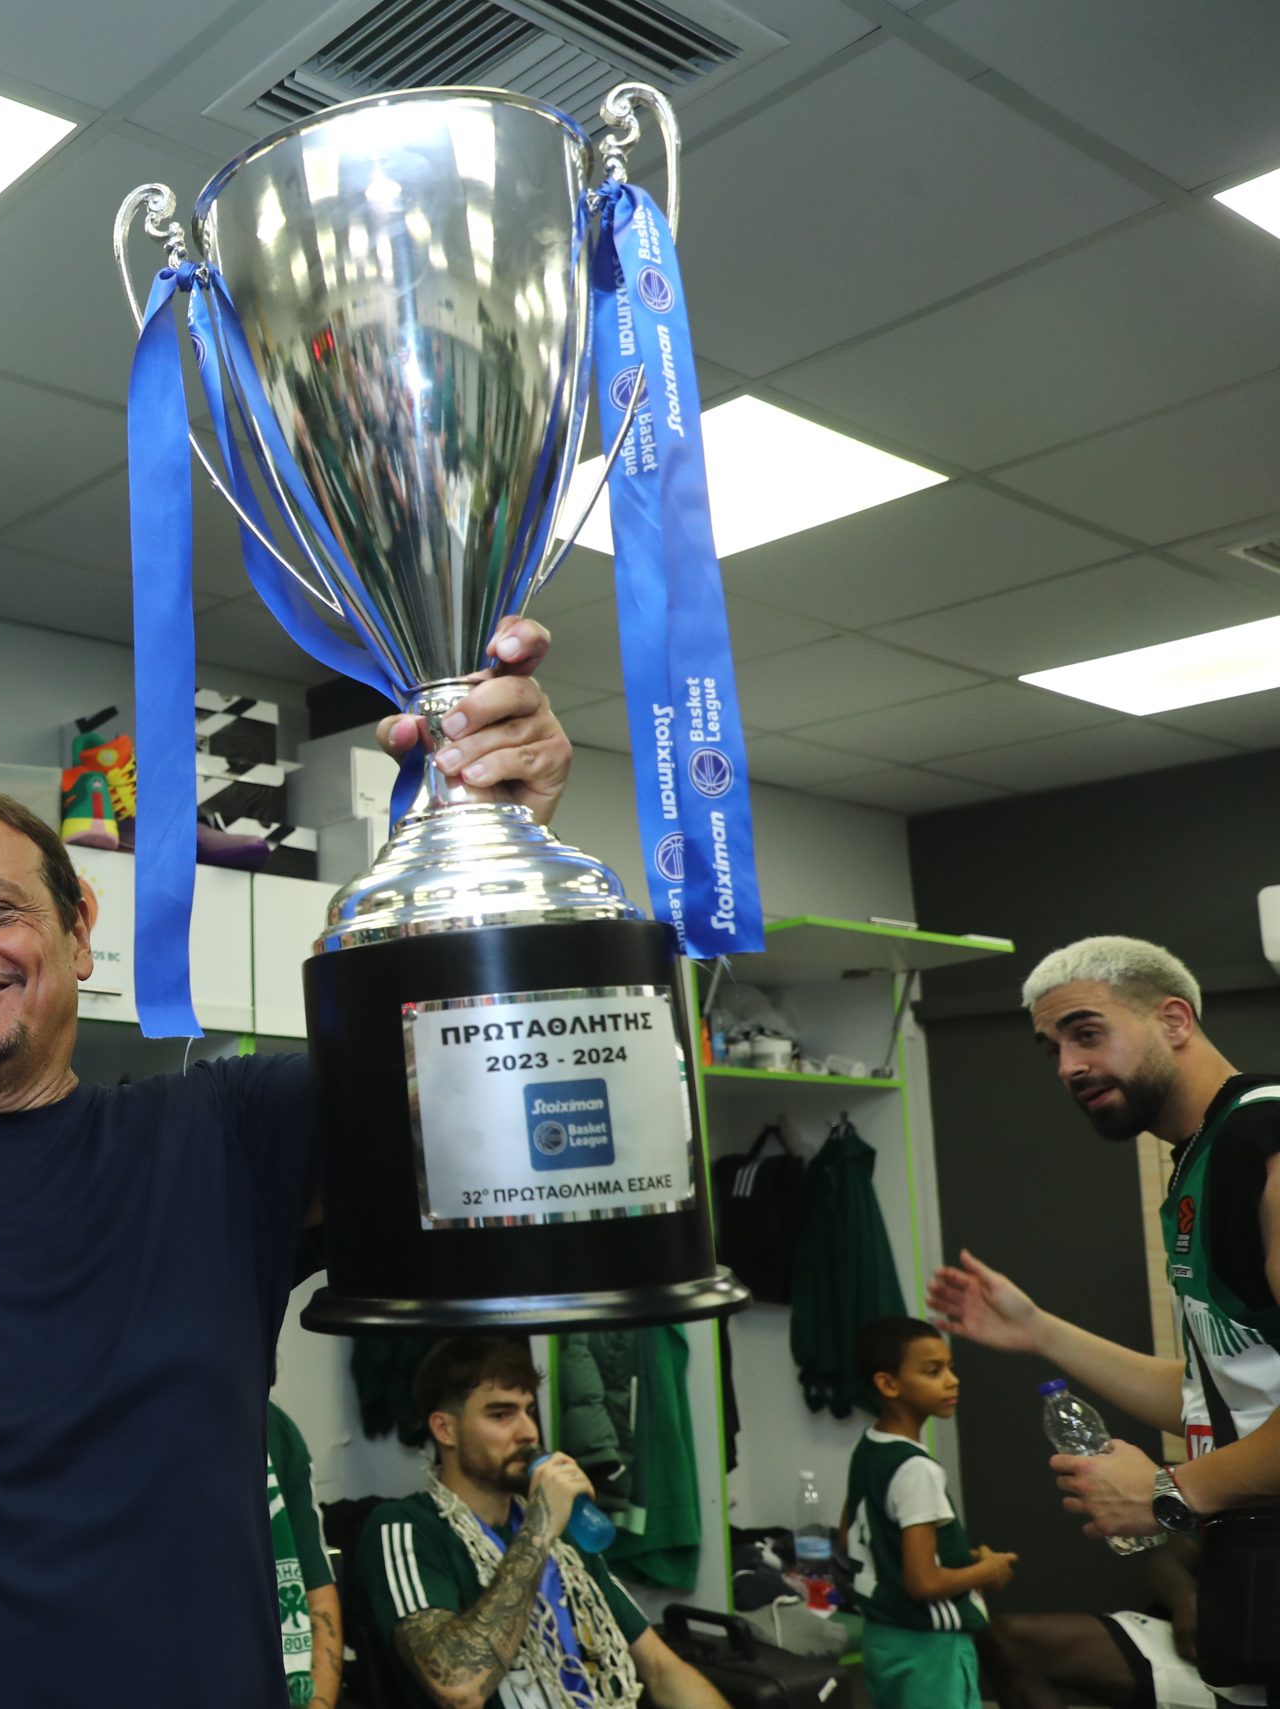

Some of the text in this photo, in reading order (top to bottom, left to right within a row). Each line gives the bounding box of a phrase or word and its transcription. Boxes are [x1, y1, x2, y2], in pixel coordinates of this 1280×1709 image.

[646, 207, 662, 265] League
[657, 324, 684, 438] Stoiximan
[619, 416, 638, 477] eague
[638, 412, 658, 473] Basket
[686, 677, 704, 742] Basket
[704, 677, 721, 743] League
[652, 704, 678, 820] Stoiximan
[710, 811, 736, 935] Stoiximan
[441, 1012, 652, 1046] ΠΡΩΤΑΘΛΗΤΗΣ
[486, 1052, 549, 1072] 2023
[573, 1046, 627, 1066] 2024
[531, 1098, 604, 1115] Stoiximan
[568, 1122, 607, 1135] Basket
[569, 1134, 608, 1148] League
[494, 1180, 624, 1203] ΠΡΩΤΑΘΛΗΜΑ
[628, 1174, 673, 1192] ΕΣΑΚΕ
